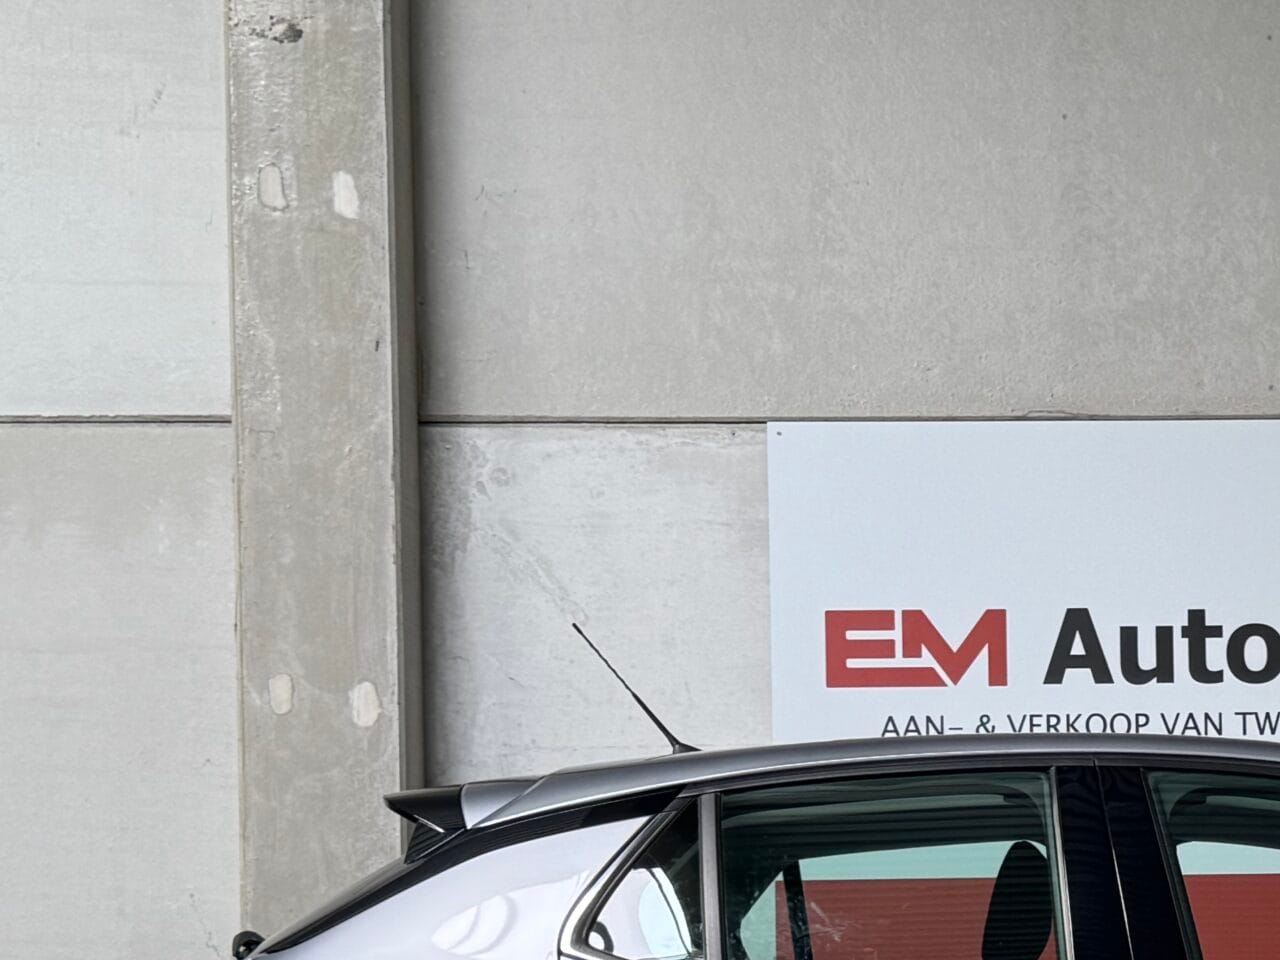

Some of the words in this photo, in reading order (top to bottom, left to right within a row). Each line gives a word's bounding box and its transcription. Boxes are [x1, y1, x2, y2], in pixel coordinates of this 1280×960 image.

[825, 609, 1008, 688] EM
[975, 714, 995, 734] &
[1007, 712, 1150, 734] VERKOOP
[1160, 712, 1223, 736] VAN
